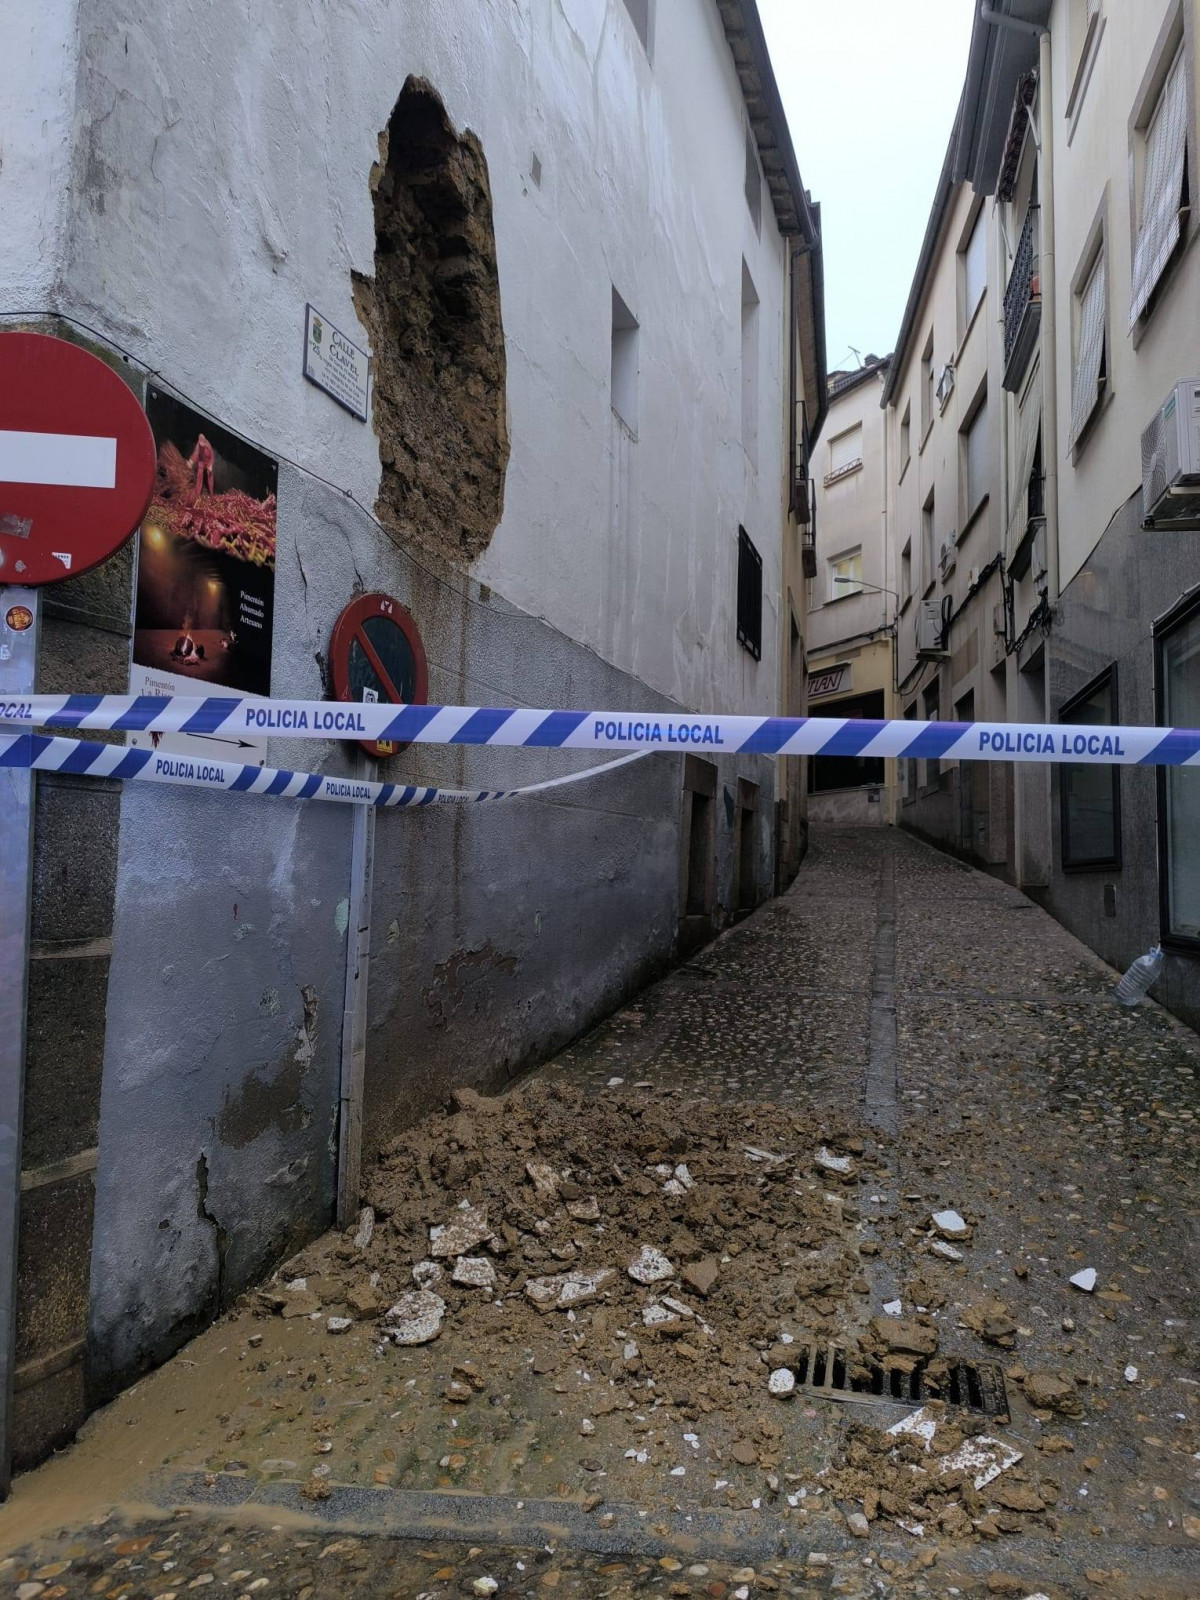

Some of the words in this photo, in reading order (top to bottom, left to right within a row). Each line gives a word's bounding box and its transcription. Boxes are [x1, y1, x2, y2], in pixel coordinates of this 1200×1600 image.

[332, 331, 354, 360] CALLE
[330, 344, 359, 377] CLAVEL
[240, 590, 264, 607] Pimentón
[240, 603, 264, 618] Ahumado
[240, 614, 262, 629] Artesano
[145, 676, 175, 691] Pimentón
[0, 702, 32, 718] OCAL
[246, 708, 308, 729] POLICIA
[314, 711, 365, 731] LOCAL
[594, 721, 662, 742] POLICIA
[668, 723, 724, 744] LOCAL
[979, 731, 1055, 754] POLICIA
[1062, 735, 1124, 756] LOCAL
[156, 759, 194, 779] POLICIA
[196, 764, 225, 783] LOCAL
[326, 782, 351, 798] POLICIA
[352, 785, 371, 799] LOCAL
